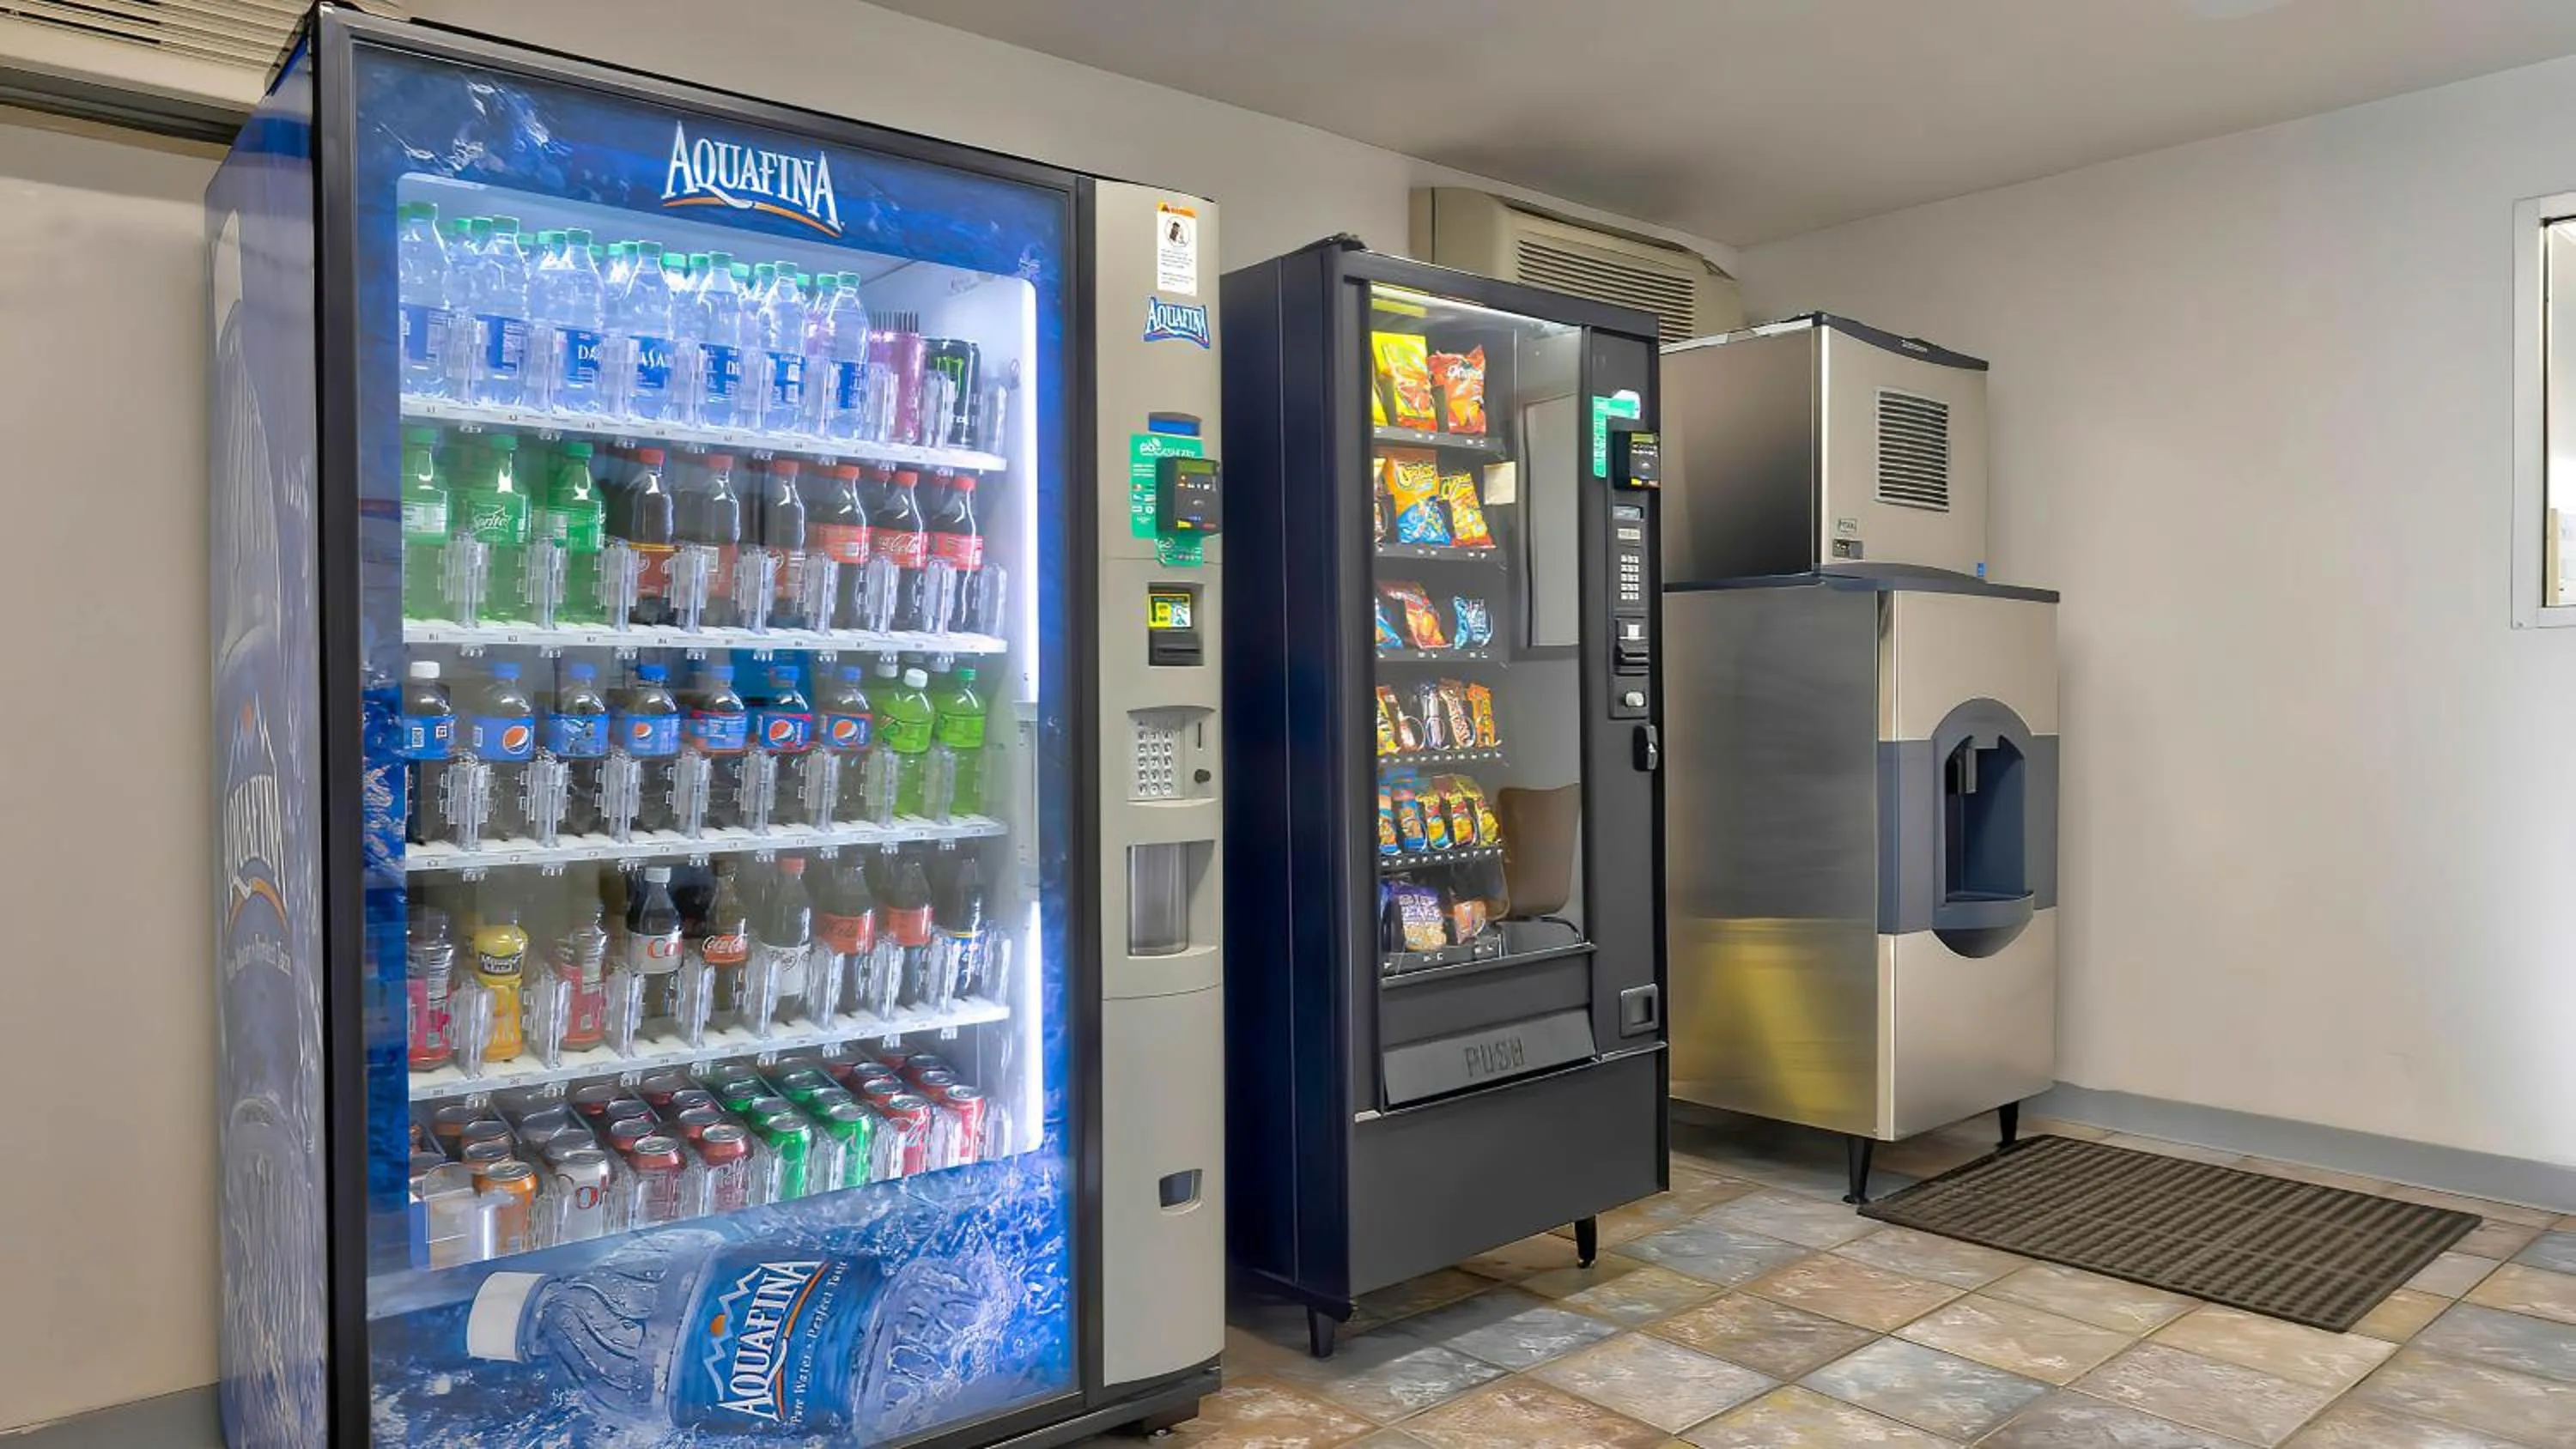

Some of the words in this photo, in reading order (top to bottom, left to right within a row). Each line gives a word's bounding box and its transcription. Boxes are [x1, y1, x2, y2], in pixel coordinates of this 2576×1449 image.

[660, 120, 842, 233] AQUAFINA
[1145, 299, 1210, 338] AQUAFINA
[717, 1260, 823, 1422] AQUAFINA
[794, 1355, 811, 1395] Water
[806, 1290, 834, 1338] Perfect
